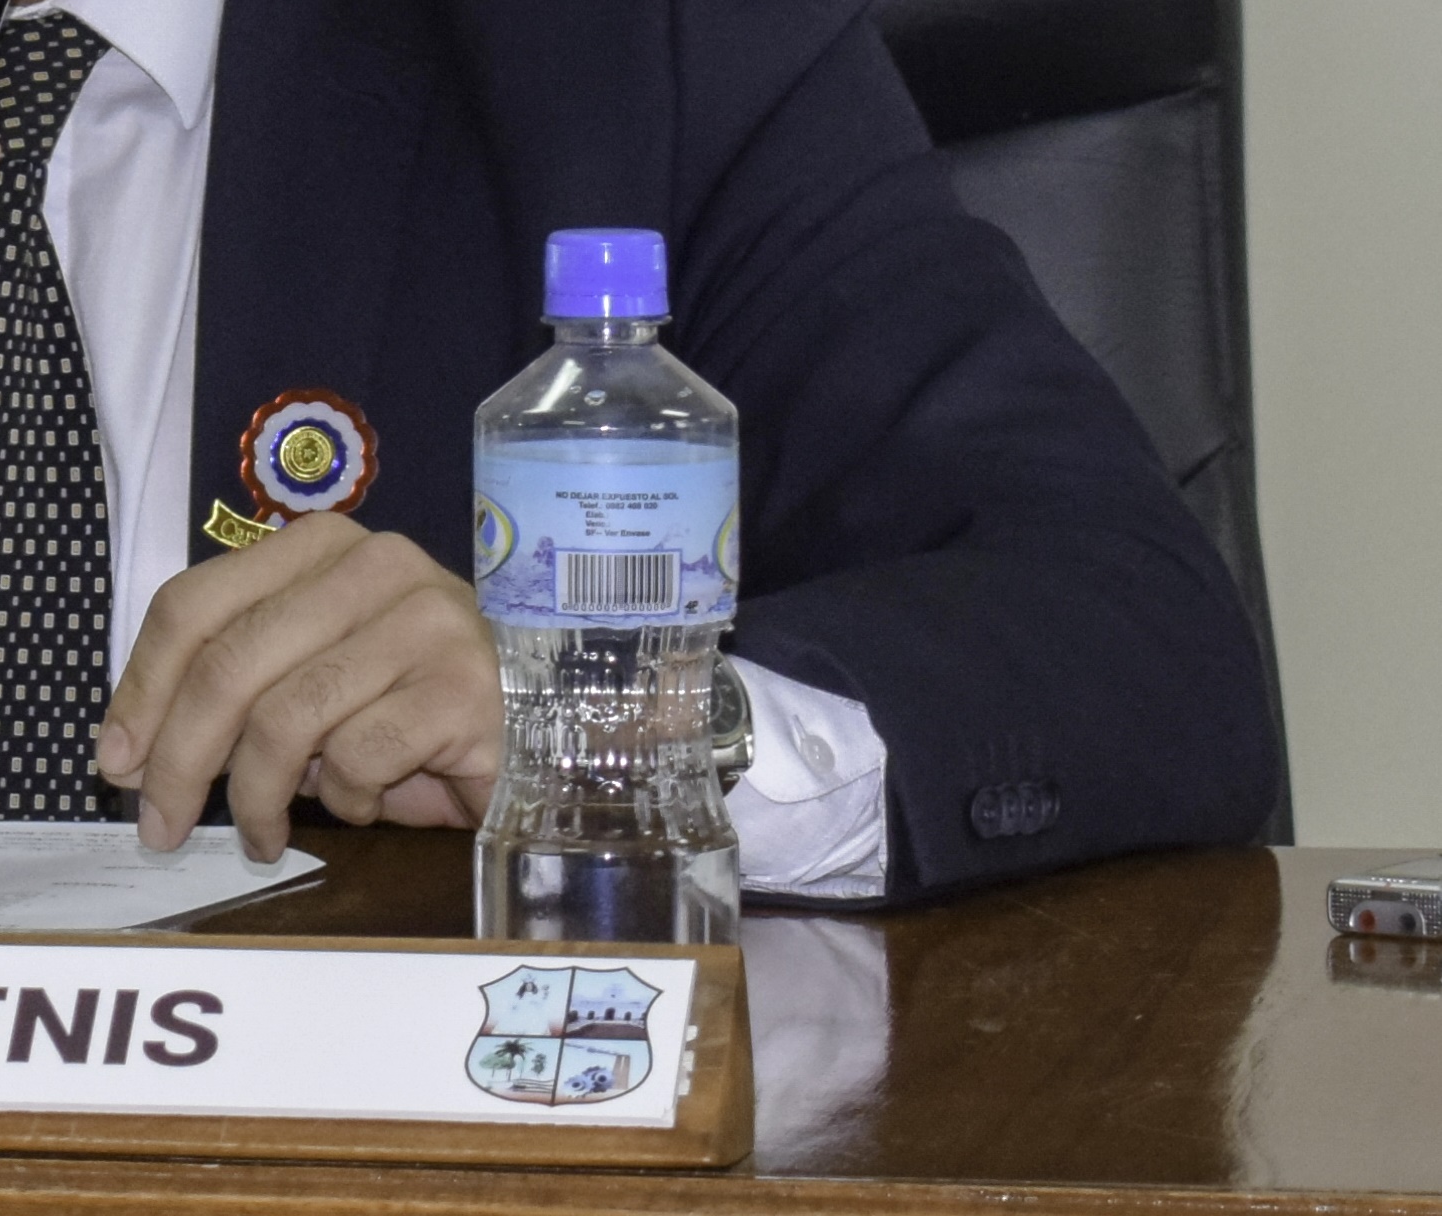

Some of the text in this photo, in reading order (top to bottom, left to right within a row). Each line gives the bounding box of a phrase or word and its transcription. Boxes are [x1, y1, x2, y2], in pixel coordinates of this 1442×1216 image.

[556, 491, 568, 499] NO
[570, 491, 599, 499] DEJAR
[602, 492, 648, 500] EXPUESTO
[663, 492, 679, 500] SOL
